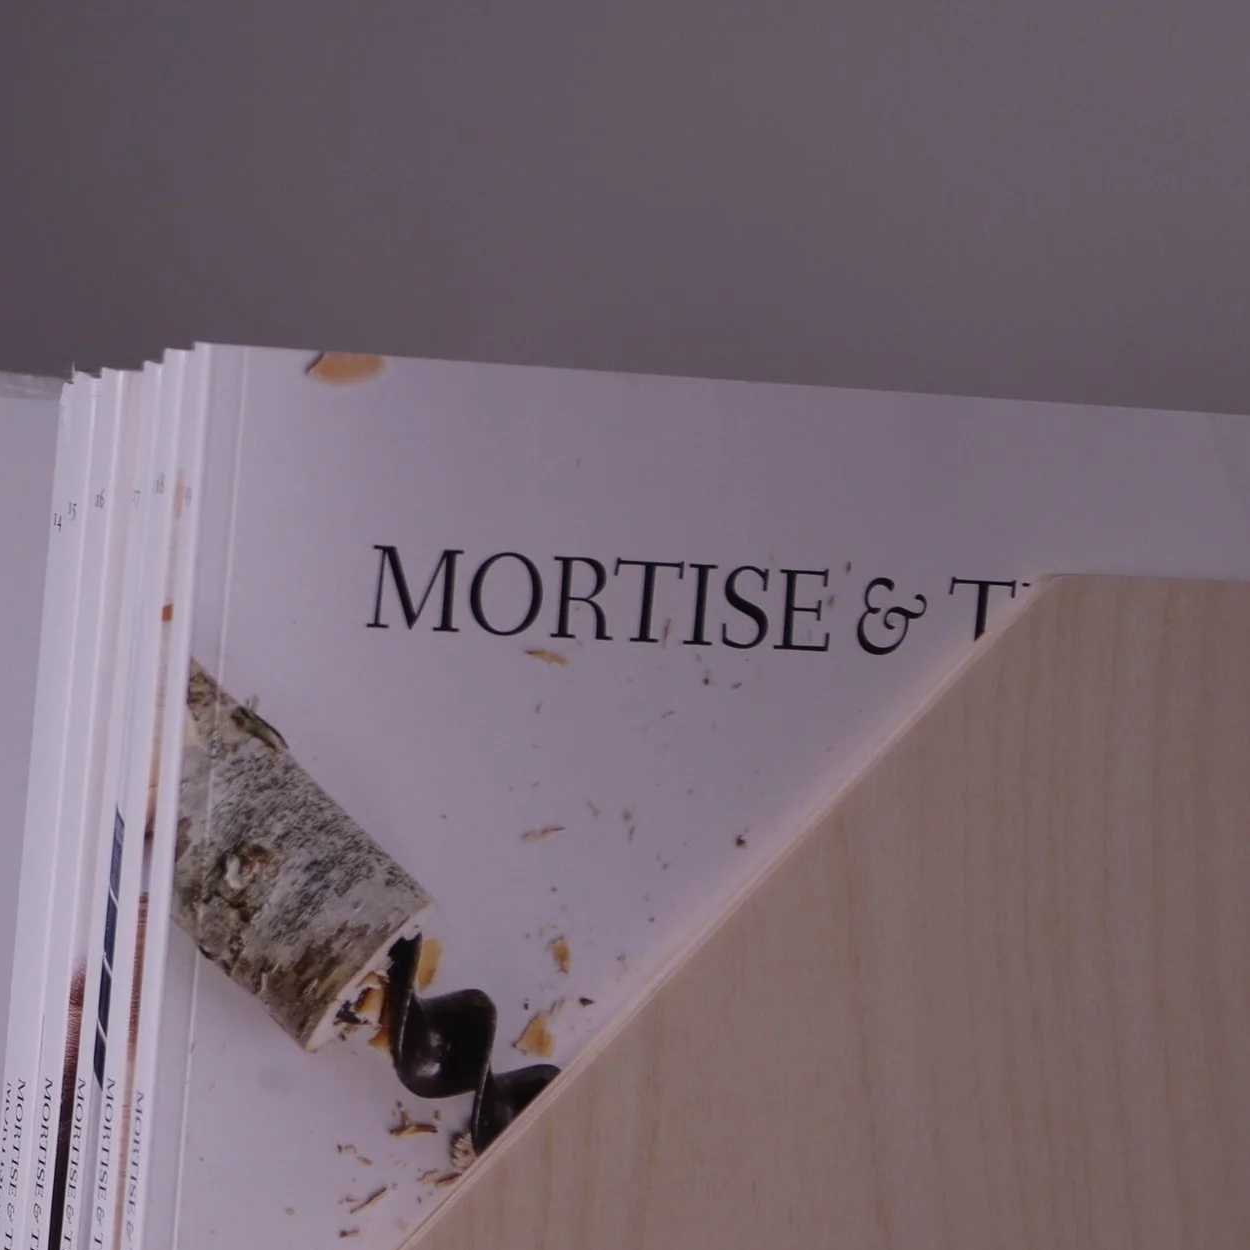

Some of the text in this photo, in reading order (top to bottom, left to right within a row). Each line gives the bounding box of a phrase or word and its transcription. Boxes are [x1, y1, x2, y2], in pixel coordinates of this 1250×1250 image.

[96, 489, 105, 509] 16
[68, 502, 77, 521] 15
[365, 543, 1031, 655] MORTISE & T
[8, 1077, 26, 1197] MORTISE
[35, 1077, 53, 1198] MORTISE
[67, 1078, 86, 1199] MORTISE
[97, 1077, 116, 1200] MORTISE
[127, 1091, 144, 1215] MORTISE
[6, 1202, 15, 1222] &
[32, 1203, 42, 1224] &
[65, 1204, 75, 1224] &
[95, 1206, 105, 1227] &
[125, 1221, 135, 1242] &
